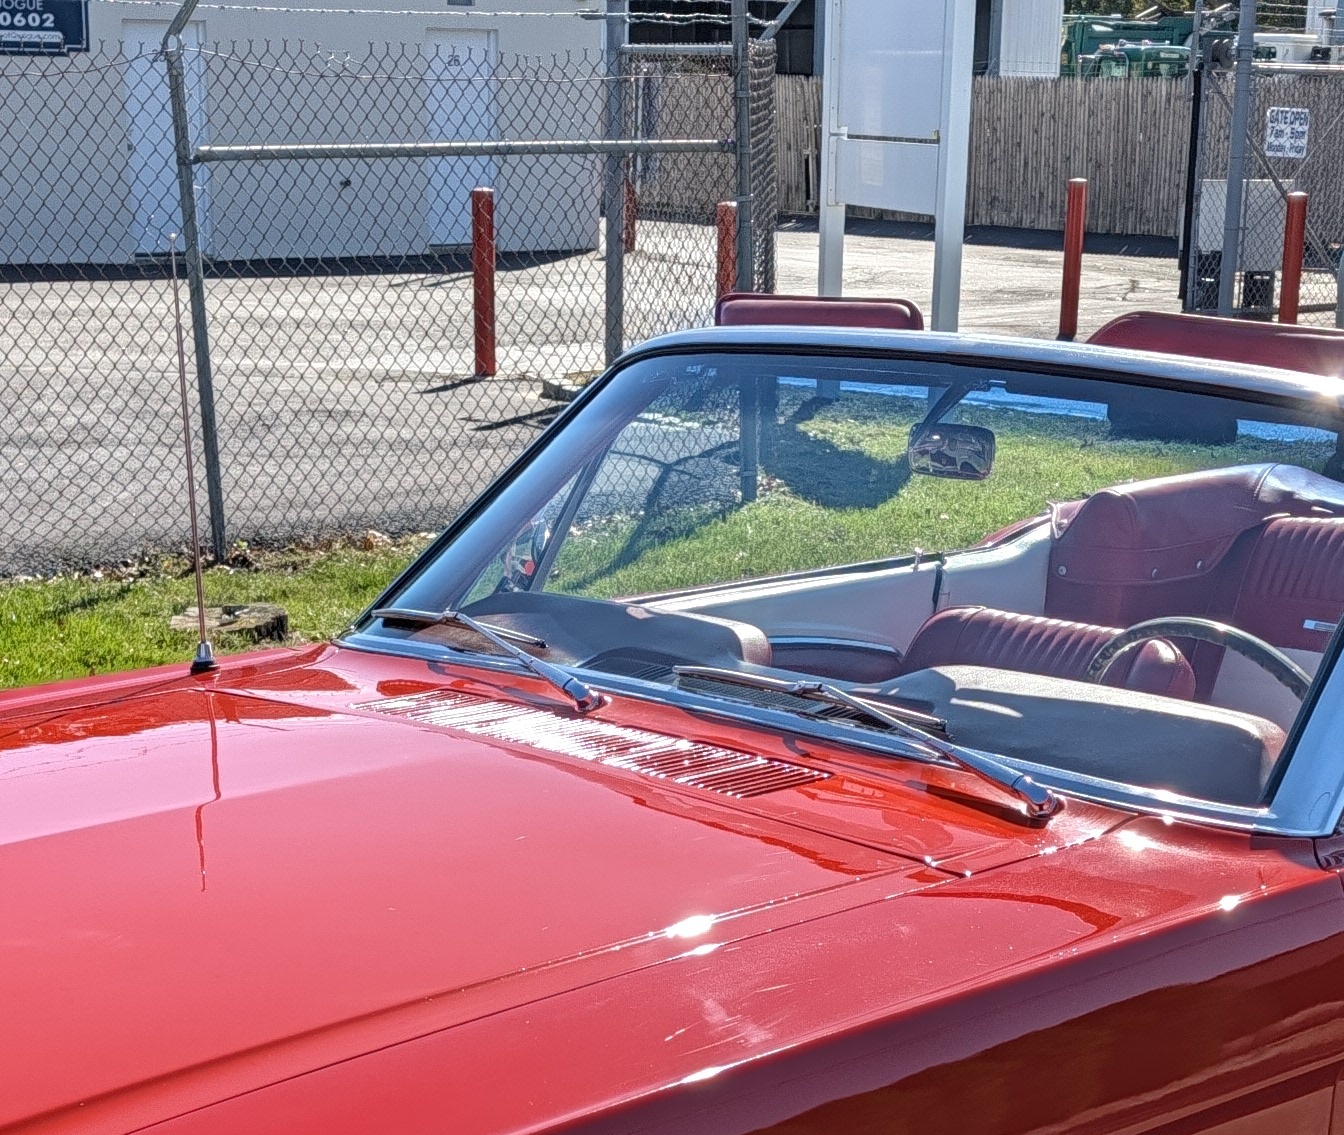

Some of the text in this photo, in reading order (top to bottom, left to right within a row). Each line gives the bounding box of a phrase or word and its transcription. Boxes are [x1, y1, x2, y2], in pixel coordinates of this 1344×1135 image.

[447, 54, 461, 67] 26
[1269, 109, 1309, 126] GATE OPEN
